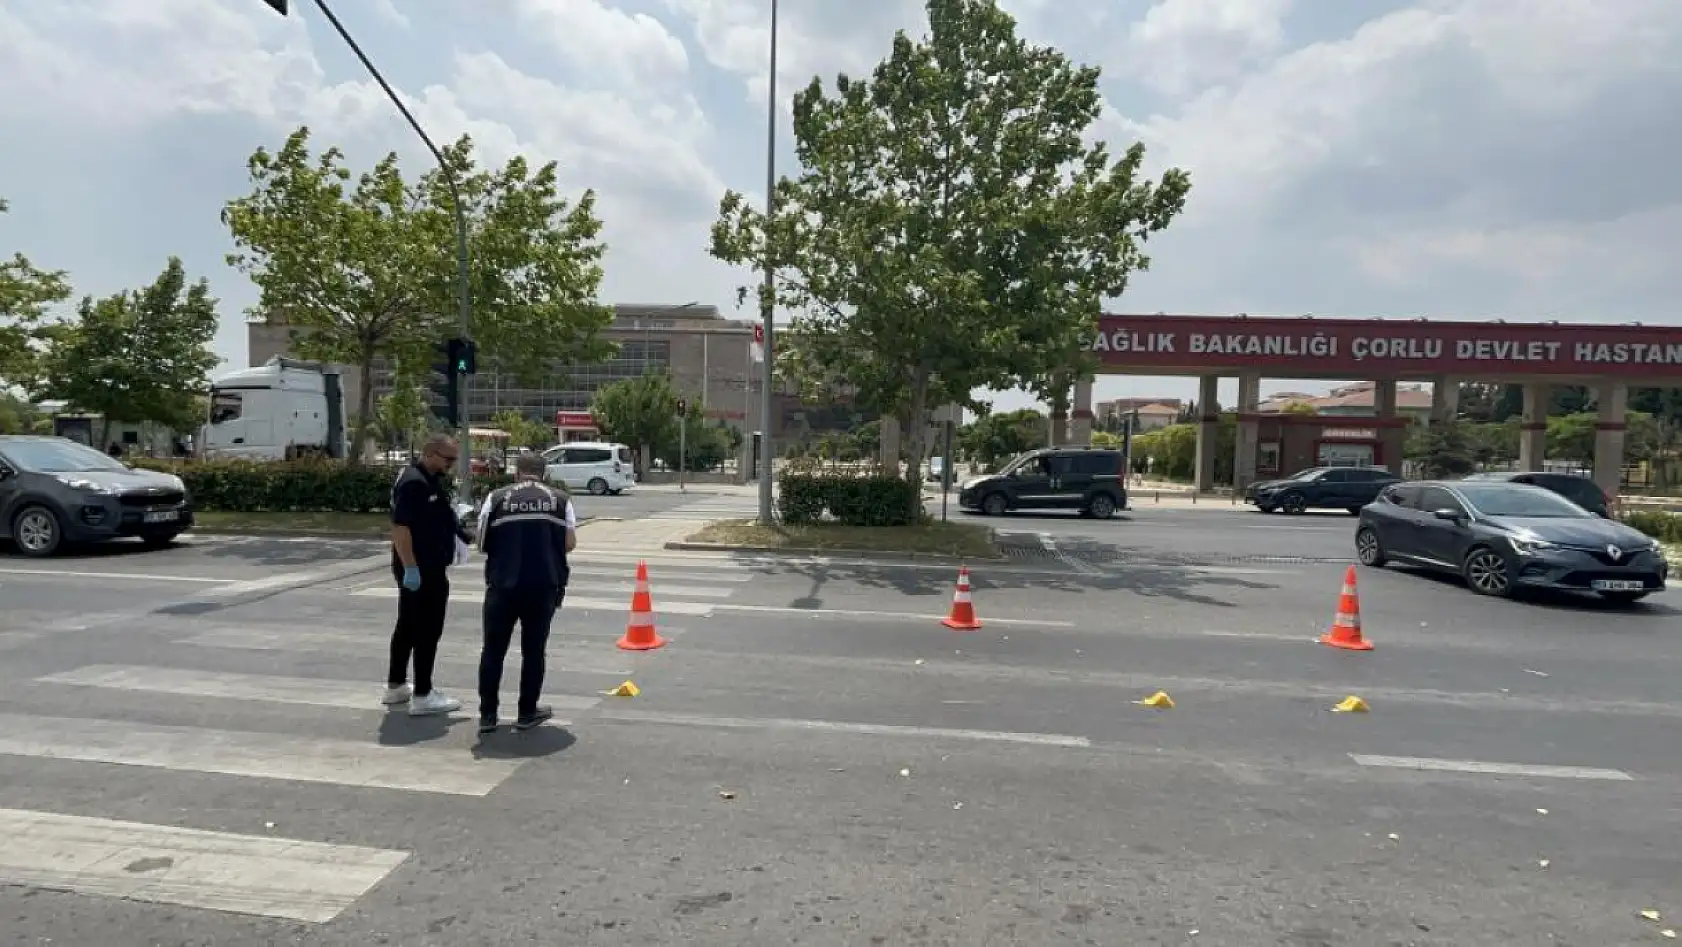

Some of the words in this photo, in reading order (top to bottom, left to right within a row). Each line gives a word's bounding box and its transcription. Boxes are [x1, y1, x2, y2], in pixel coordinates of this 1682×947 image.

[1189, 332, 1338, 357] BAKANLIĞI
[1351, 336, 1443, 361] ÇORLU
[1456, 339, 1562, 361] DEVLET
